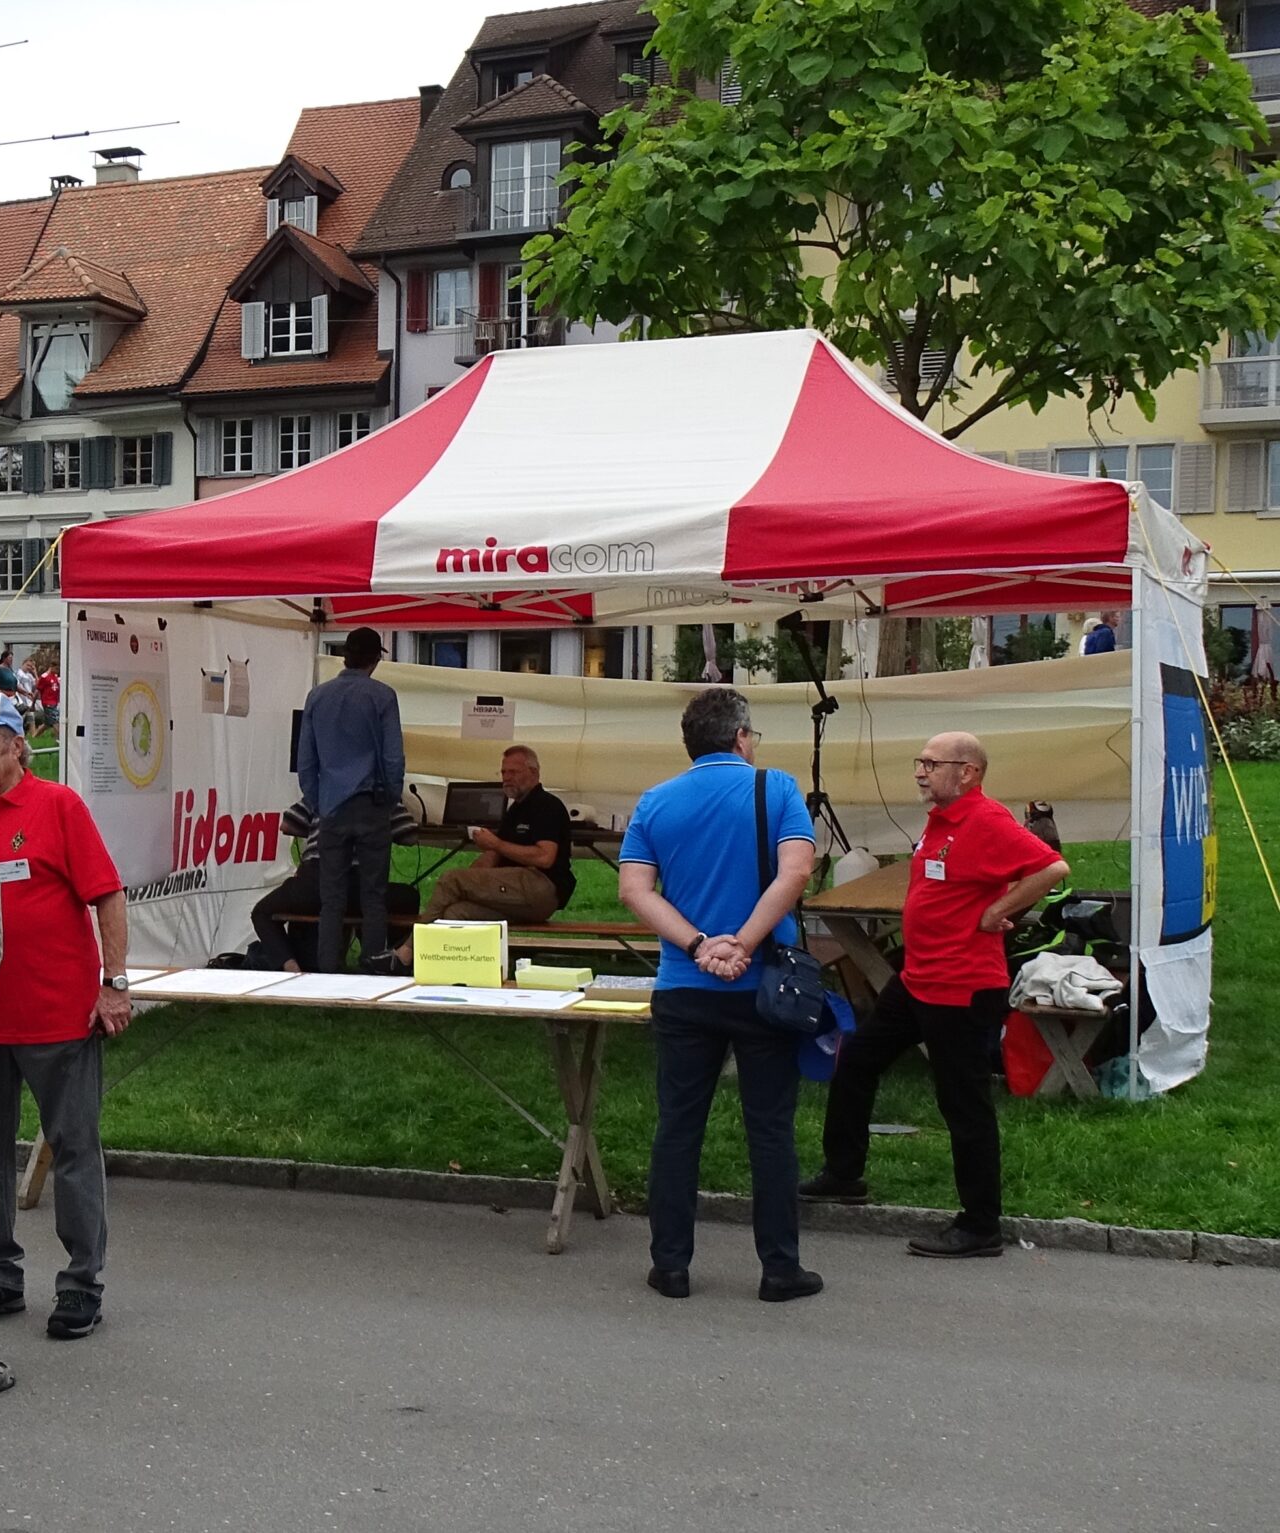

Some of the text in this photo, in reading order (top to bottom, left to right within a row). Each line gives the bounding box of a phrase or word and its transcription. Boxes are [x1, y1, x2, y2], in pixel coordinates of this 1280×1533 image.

[436, 537, 655, 574] miracom
[442, 943, 471, 952] Einwurf
[420, 953, 496, 962] Wettbewerbs-Karten
